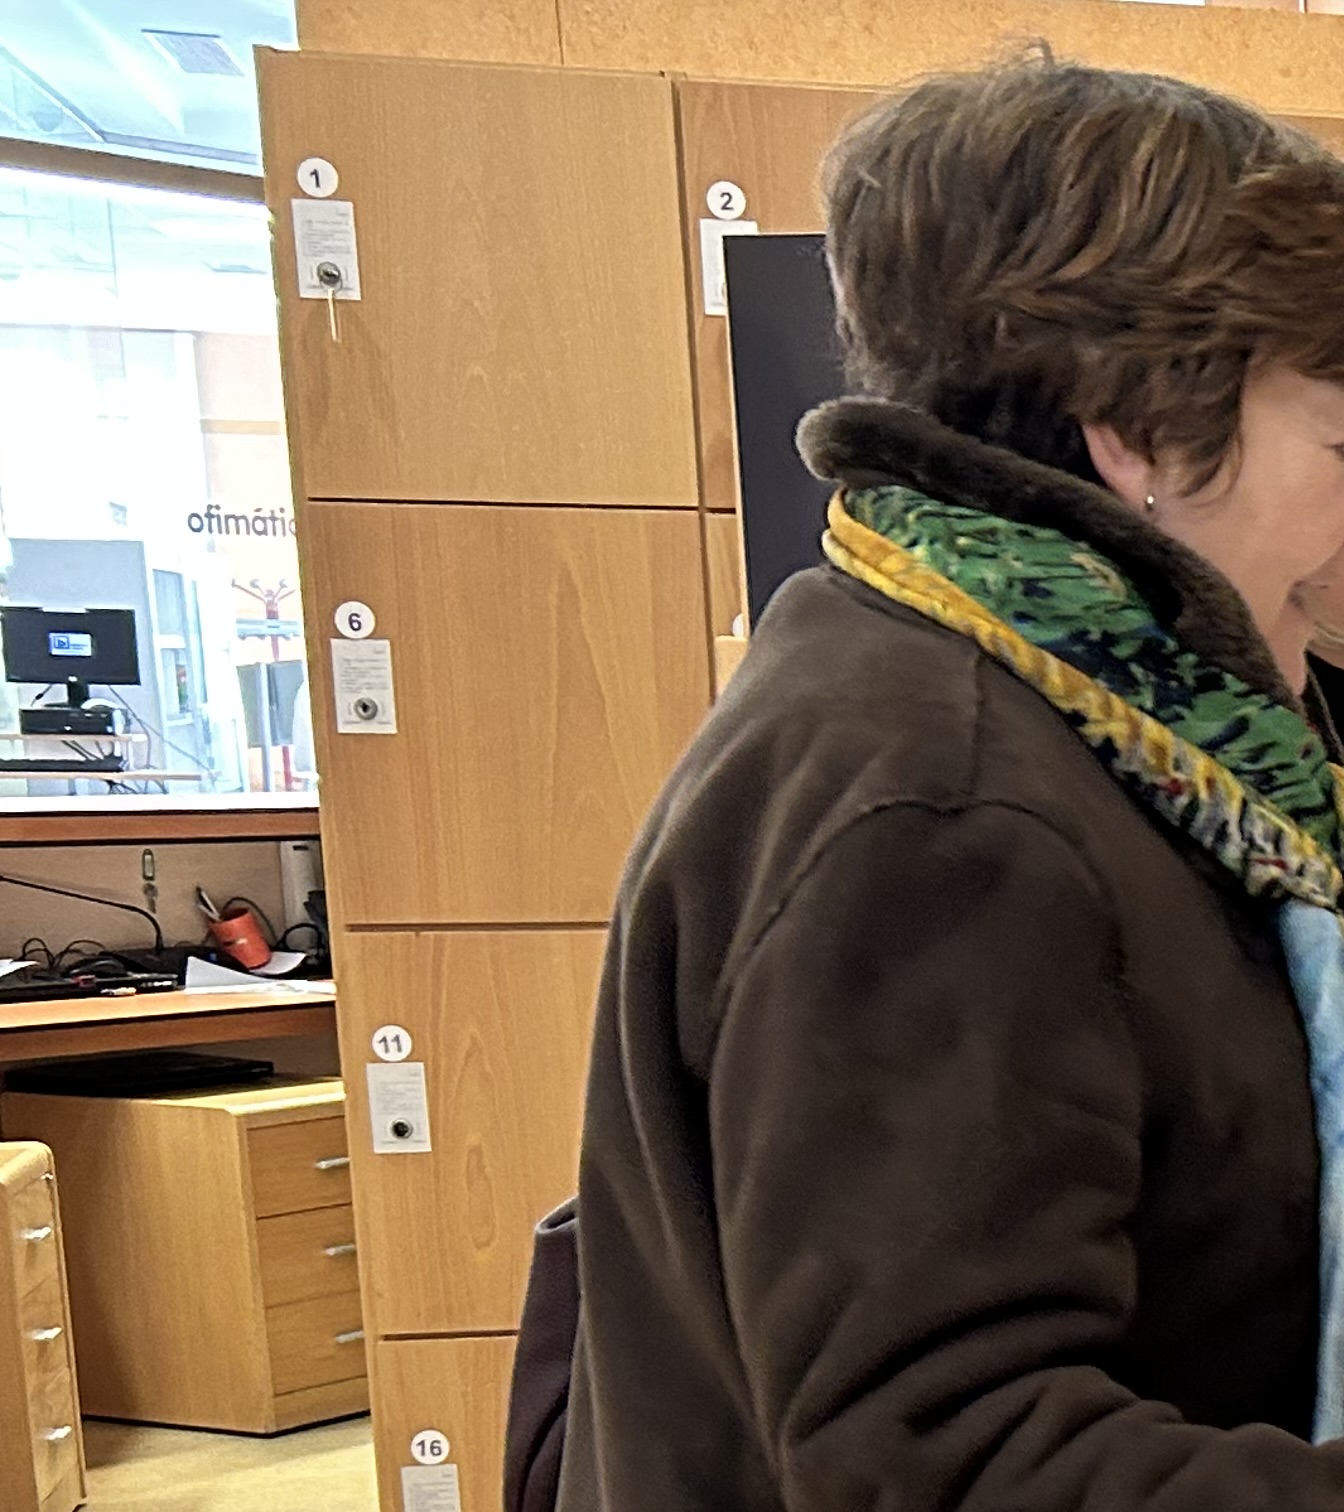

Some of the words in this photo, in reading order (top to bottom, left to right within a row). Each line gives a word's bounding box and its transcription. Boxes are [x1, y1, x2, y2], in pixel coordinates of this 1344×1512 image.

[310, 168, 321, 189] 1
[720, 191, 734, 211] 2
[348, 612, 362, 632] 6
[377, 1034, 403, 1054] 11
[416, 1439, 443, 1457] 16
